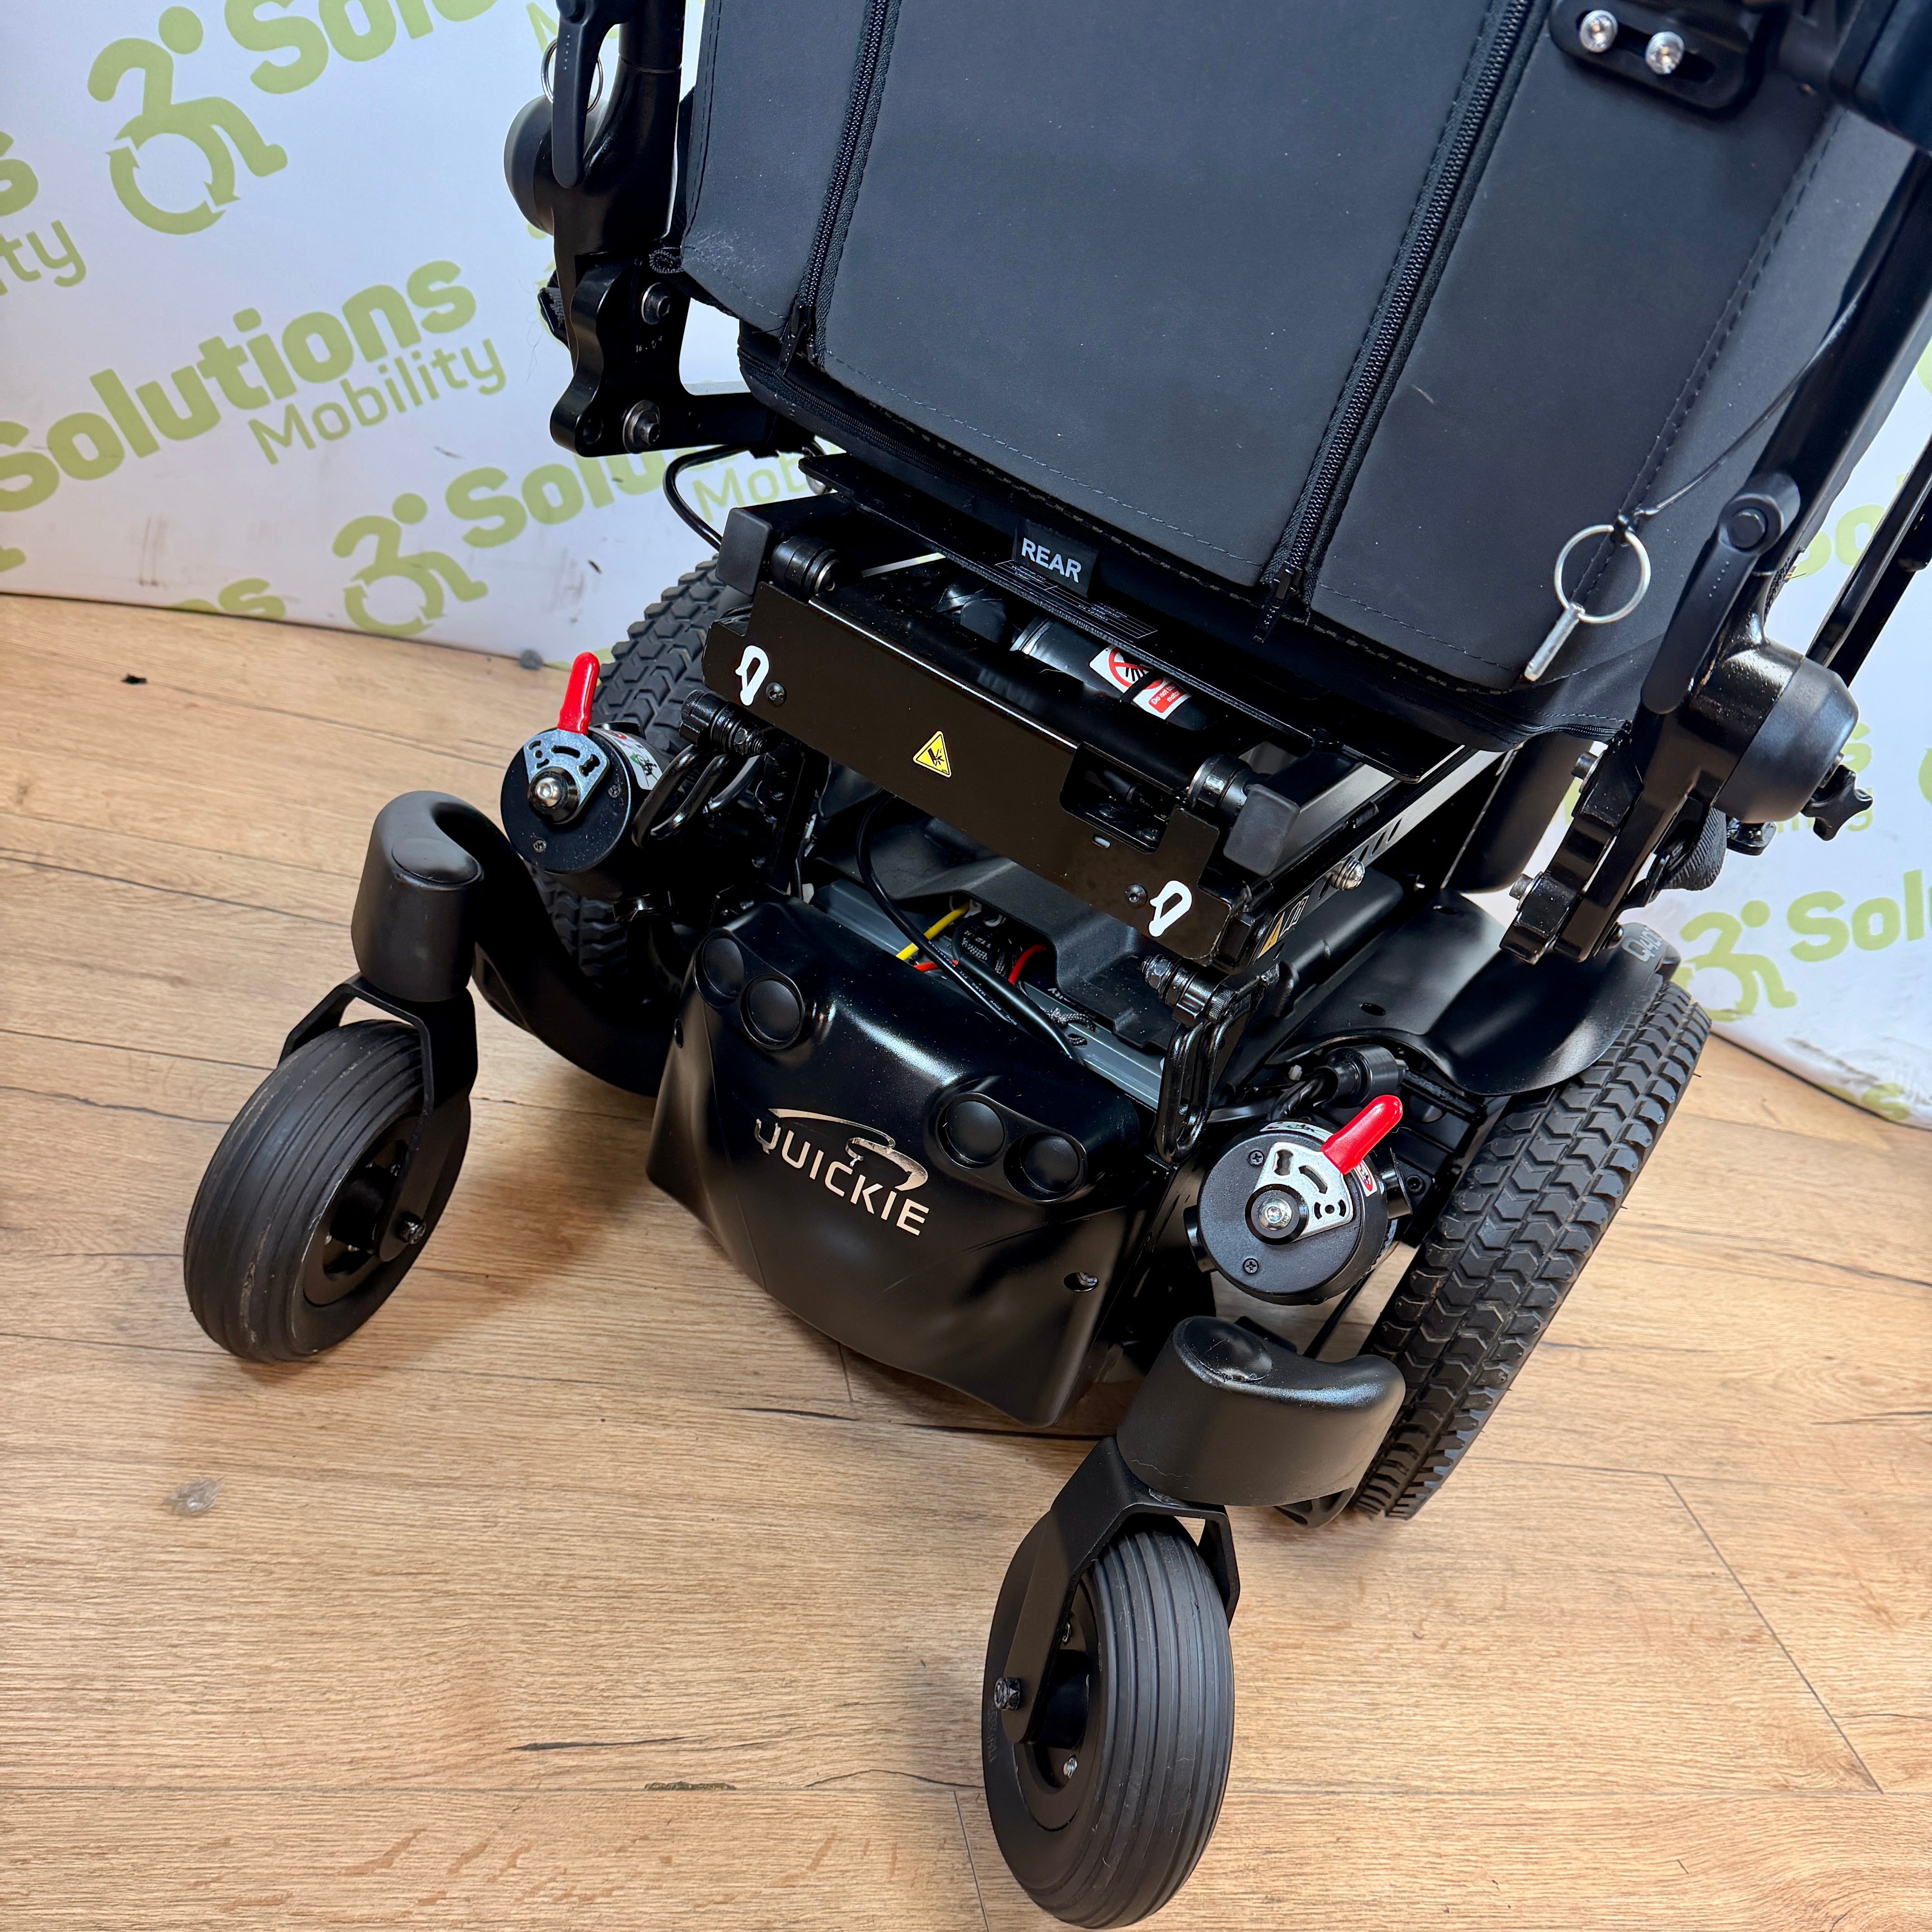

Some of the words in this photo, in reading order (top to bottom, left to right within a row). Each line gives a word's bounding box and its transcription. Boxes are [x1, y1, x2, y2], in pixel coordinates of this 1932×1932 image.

[248, 338, 506, 465] Mobility
[1021, 538, 1081, 583] REAR
[1151, 696, 1161, 705] Do
[1159, 689, 1169, 698] not
[754, 1118, 929, 1236] QUICKIE
